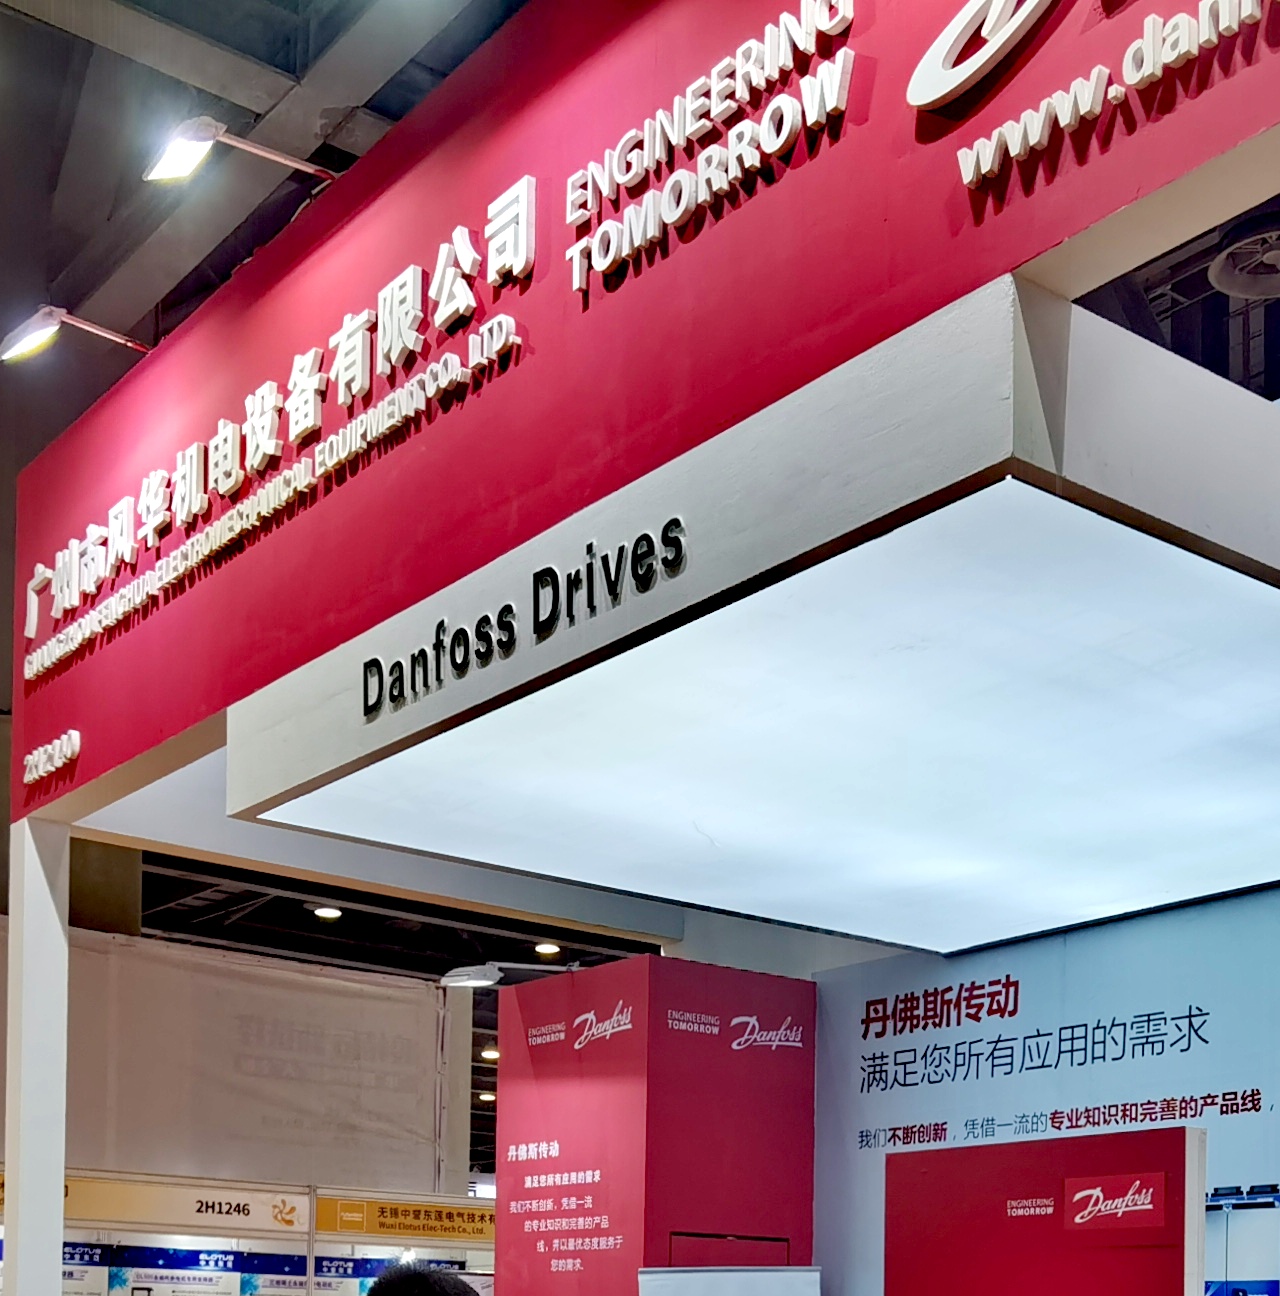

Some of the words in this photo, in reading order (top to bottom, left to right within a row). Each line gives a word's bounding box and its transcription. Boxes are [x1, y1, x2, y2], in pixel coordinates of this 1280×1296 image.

[566, 0, 854, 226] ENGINEERING
[566, 48, 855, 292] TOMORROW
[24, 175, 536, 639] 广州市风华机电设备有限公司
[314, 373, 426, 477] EQUIPMENT
[362, 602, 518, 723] Danfoss
[531, 516, 687, 640] Drives
[572, 999, 633, 1050] Danfoss
[667, 1009, 720, 1025] ENGINEERING
[860, 973, 1020, 1041] 丹佛斯传动
[528, 1021, 566, 1037] ENGINEERING
[528, 1033, 566, 1046] TOMORROW
[667, 1020, 720, 1036] TOMORROW
[728, 1015, 804, 1051] Danfoss
[859, 1004, 1211, 1094] 满足您所有应用的需求
[507, 1139, 560, 1162] 丹佛斯传动
[524, 1169, 601, 1189] 满足您所有应用的需求
[195, 1200, 251, 1217] 2H1246
[1006, 1197, 1055, 1208] ENGINEERING
[1006, 1206, 1055, 1217] TOMORROW
[1072, 1179, 1154, 1224] Danfoss
